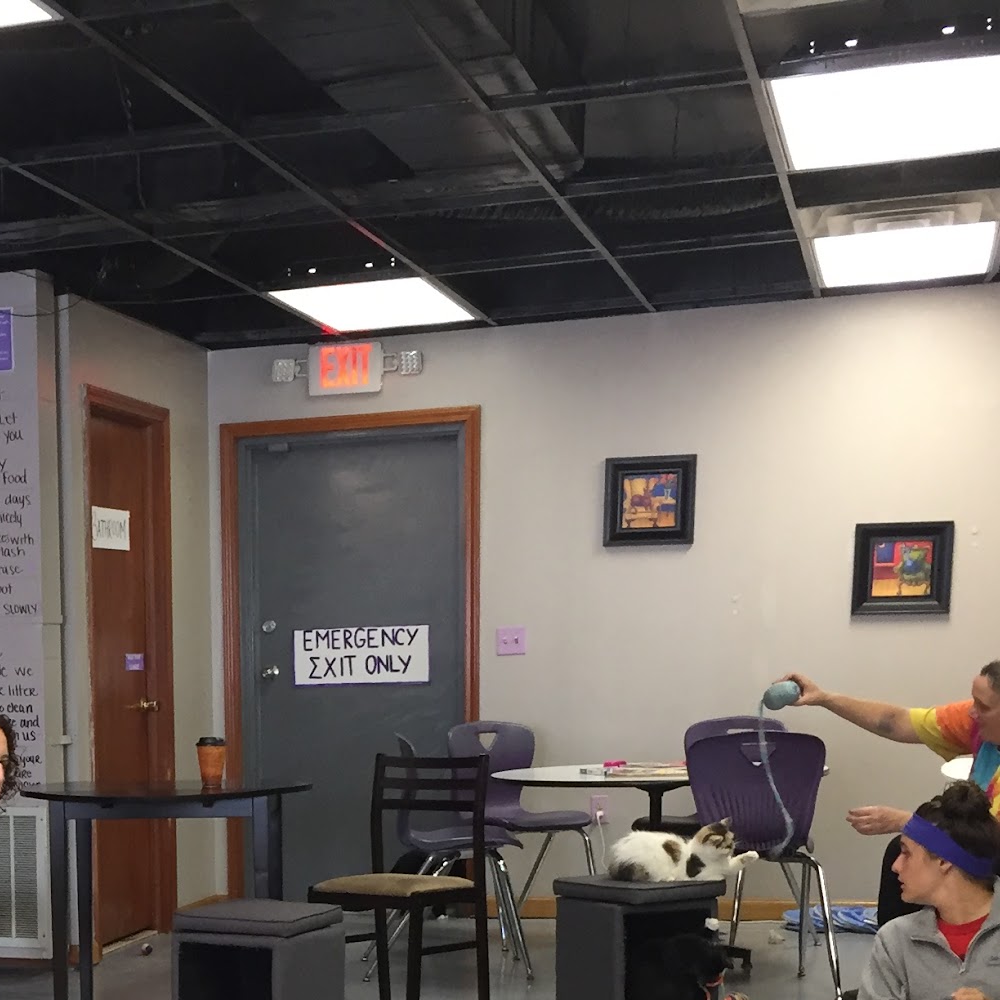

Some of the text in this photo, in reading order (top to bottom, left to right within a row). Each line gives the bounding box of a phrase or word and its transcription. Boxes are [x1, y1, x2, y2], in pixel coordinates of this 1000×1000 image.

[320, 343, 372, 388] EXIT
[4, 430, 24, 444] you
[3, 468, 28, 484] food
[4, 494, 32, 509] days
[10, 533, 34, 546] with
[303, 628, 418, 651] EMERGENCY
[15, 666, 34, 676] we
[365, 655, 412, 675] ONLY
[8, 684, 38, 696] litter
[7, 702, 33, 714] clean
[20, 715, 40, 728] and
[22, 730, 36, 741] us
[20, 755, 42, 768] your
